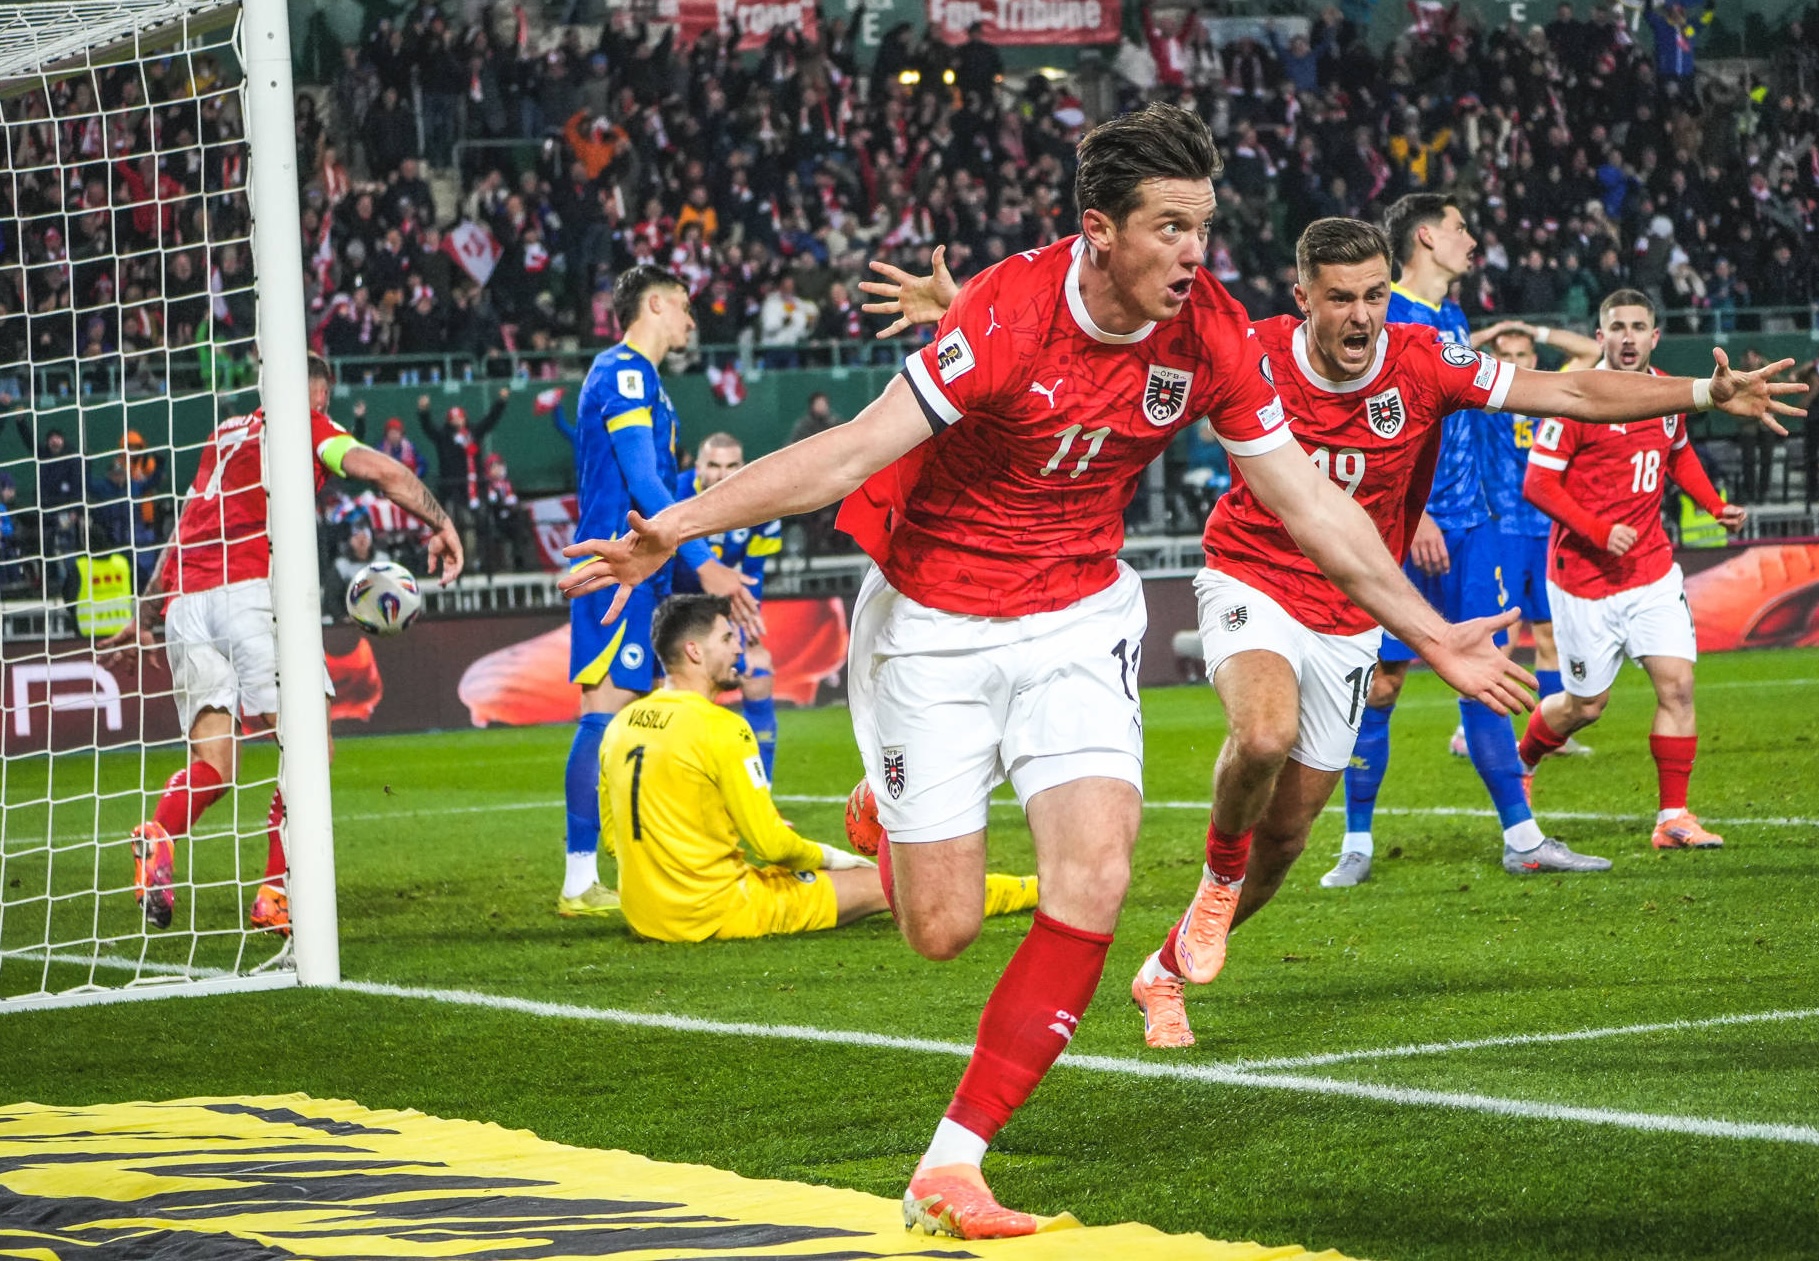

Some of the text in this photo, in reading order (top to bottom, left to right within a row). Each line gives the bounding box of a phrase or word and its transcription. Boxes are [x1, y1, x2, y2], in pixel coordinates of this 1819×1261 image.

[862, 12, 881, 46] E
[1040, 424, 1112, 479] 11
[1513, 420, 1534, 449] 15
[204, 426, 249, 501] 7
[1309, 446, 1366, 497] 19
[1630, 450, 1661, 494] 18
[627, 708, 674, 730] VASILJ
[624, 744, 646, 842] 1
